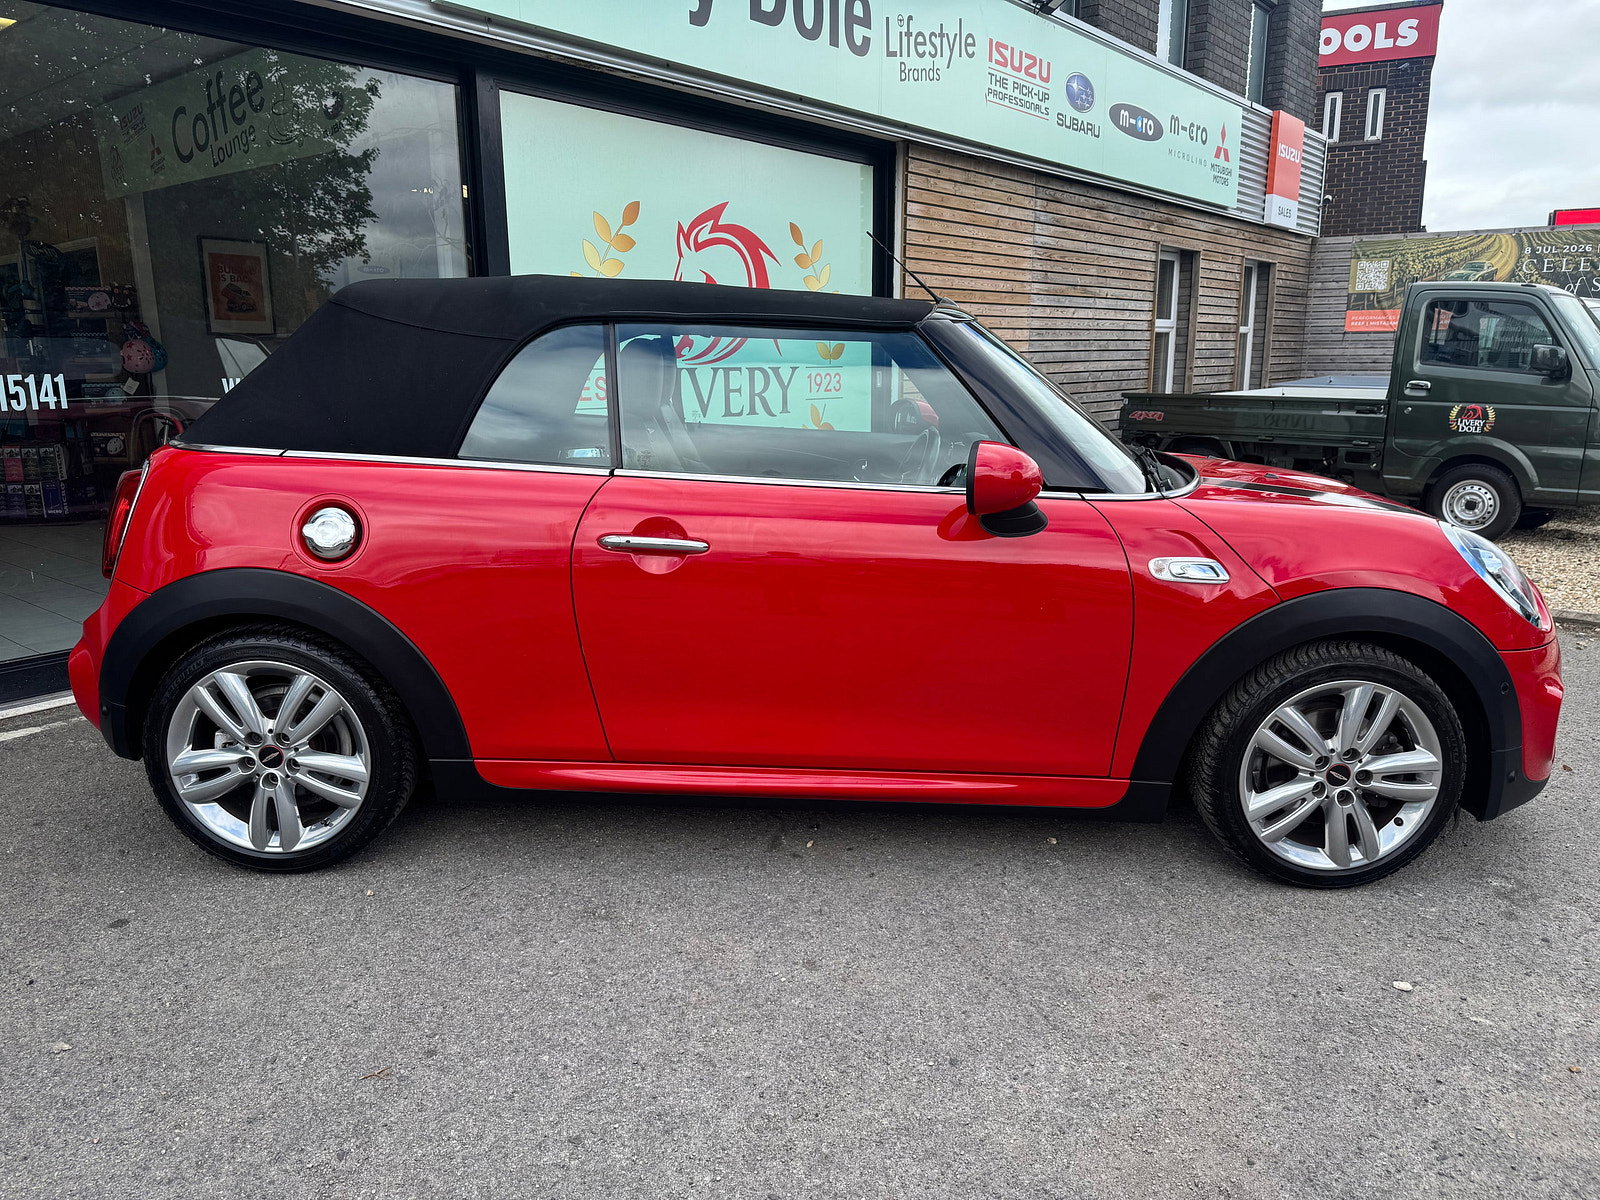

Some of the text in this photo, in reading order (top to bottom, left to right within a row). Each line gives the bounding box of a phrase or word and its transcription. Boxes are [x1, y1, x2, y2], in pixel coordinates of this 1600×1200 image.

[886, 14, 976, 69] Lifestyle
[1319, 19, 1419, 55] OOLS
[988, 37, 1051, 83] ISUZU
[900, 60, 941, 82] Brands
[988, 72, 1050, 103] THE PICK-UP
[987, 87, 1050, 116] PROFESSIONALS
[172, 71, 265, 163] Coffee
[1056, 113, 1101, 138] SUBARU
[210, 125, 256, 167] Lounge
[1278, 143, 1301, 164] ISUZU
[1168, 148, 1208, 168] MICROLINO
[1210, 162, 1232, 177] MITSUBISHI
[1213, 174, 1229, 186] MOTORS
[1278, 206, 1292, 219] SALES
[1536, 245, 1558, 254] JUL
[1563, 244, 1593, 253] 2026
[1523, 256, 1600, 273] CELE
[1564, 277, 1586, 295] of
[807, 372, 842, 393] 1923
[1457, 418, 1485, 426] LIVERY
[1458, 424, 1482, 433] DOLE
